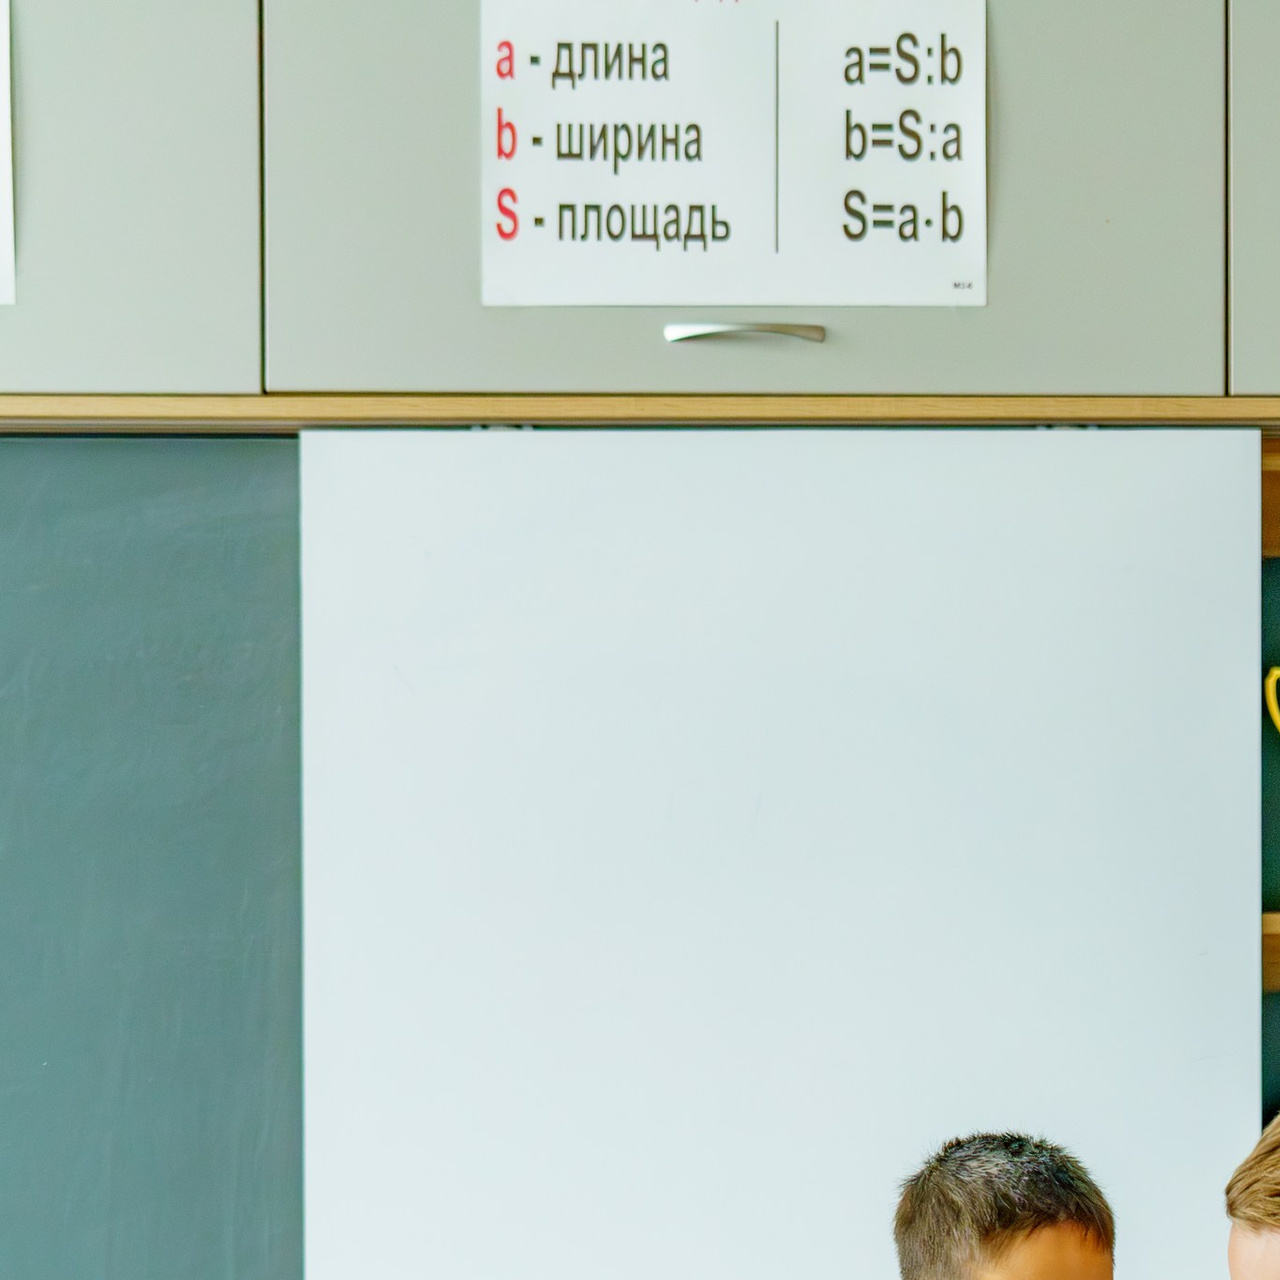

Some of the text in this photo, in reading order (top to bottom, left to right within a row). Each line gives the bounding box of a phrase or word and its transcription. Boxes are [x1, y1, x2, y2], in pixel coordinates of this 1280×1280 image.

[551, 40, 671, 89] длина
[555, 120, 704, 176] ширина
[495, 187, 520, 242] S
[557, 202, 732, 252] площадь
